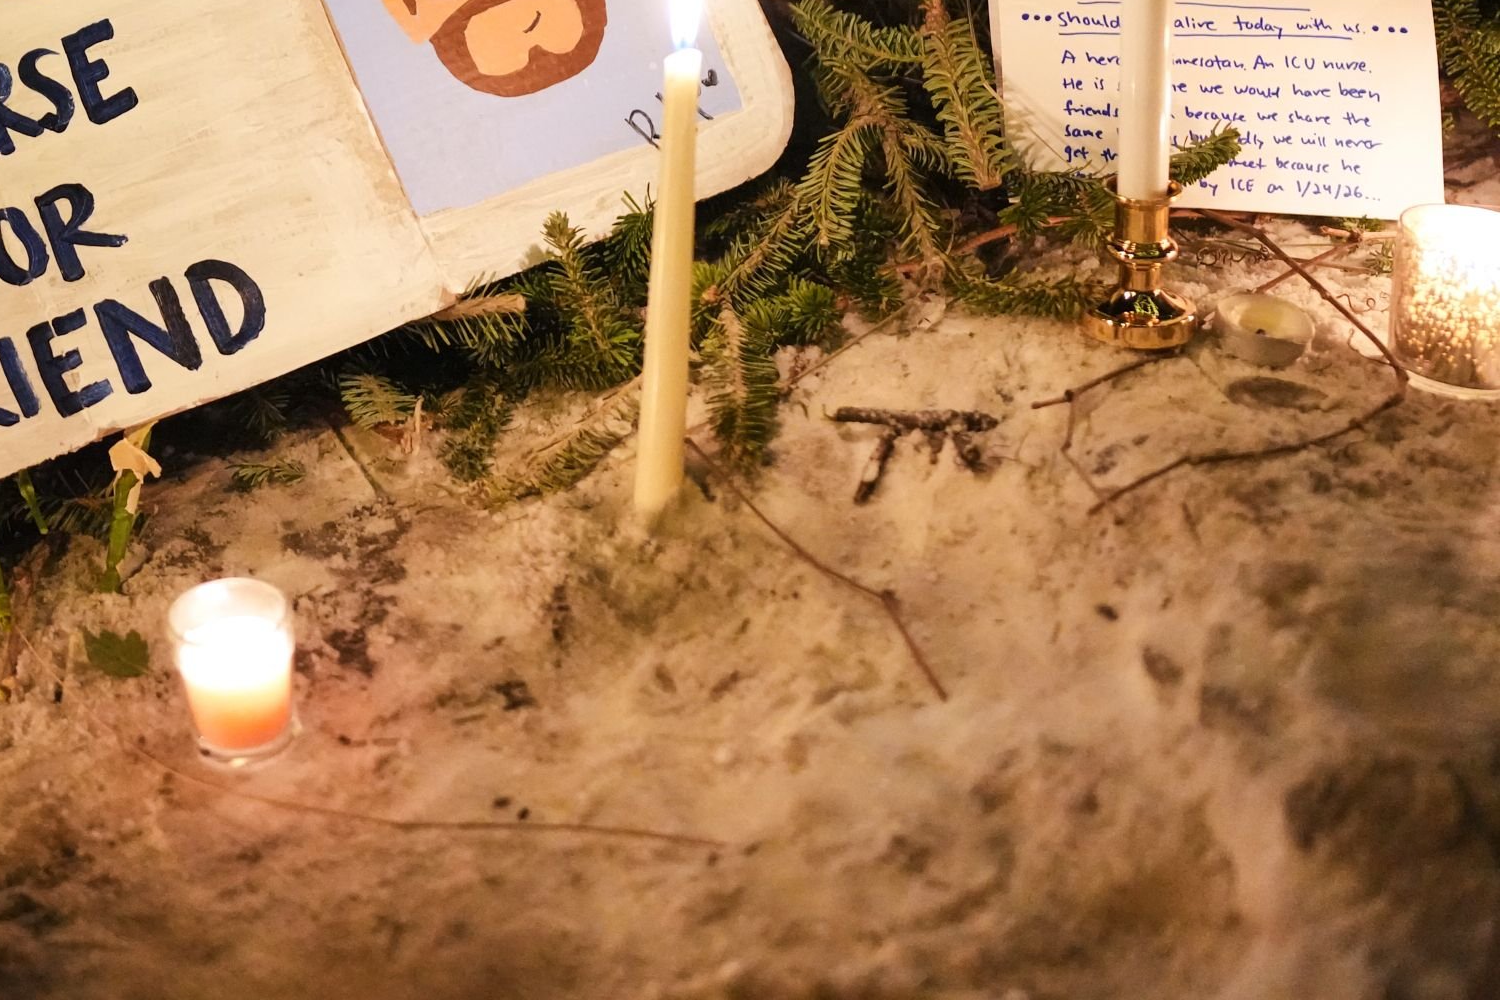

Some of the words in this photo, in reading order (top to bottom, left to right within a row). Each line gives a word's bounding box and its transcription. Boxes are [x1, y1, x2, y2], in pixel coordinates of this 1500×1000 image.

[1174, 15, 1218, 32] alive
[1233, 15, 1284, 40] today
[1296, 17, 1333, 32] with
[1061, 49, 1077, 65] A
[1253, 54, 1275, 71] An
[1284, 55, 1316, 71] ICU
[1323, 60, 1373, 74] nurse.
[1062, 77, 1084, 91] He
[1093, 76, 1105, 90] is
[1199, 84, 1225, 95] we
[1233, 85, 1281, 99] would
[1292, 83, 1332, 98] have
[1338, 81, 1381, 103] been
[1063, 99, 1119, 118] friends
[1184, 105, 1247, 122] because
[1257, 111, 1279, 122] we
[1288, 110, 1332, 125] share
[1342, 111, 1372, 128] the
[1064, 124, 1104, 140] same
[1272, 135, 1293, 145] we
[1301, 132, 1326, 148] will
[1334, 137, 1384, 150] never
[1064, 145, 1089, 163] get
[1228, 157, 1268, 170] meet
[1275, 156, 1331, 174] because
[1340, 159, 1362, 175] he
[1199, 178, 1219, 197] by
[1230, 177, 1255, 193] ICE
[1267, 183, 1285, 194] on
